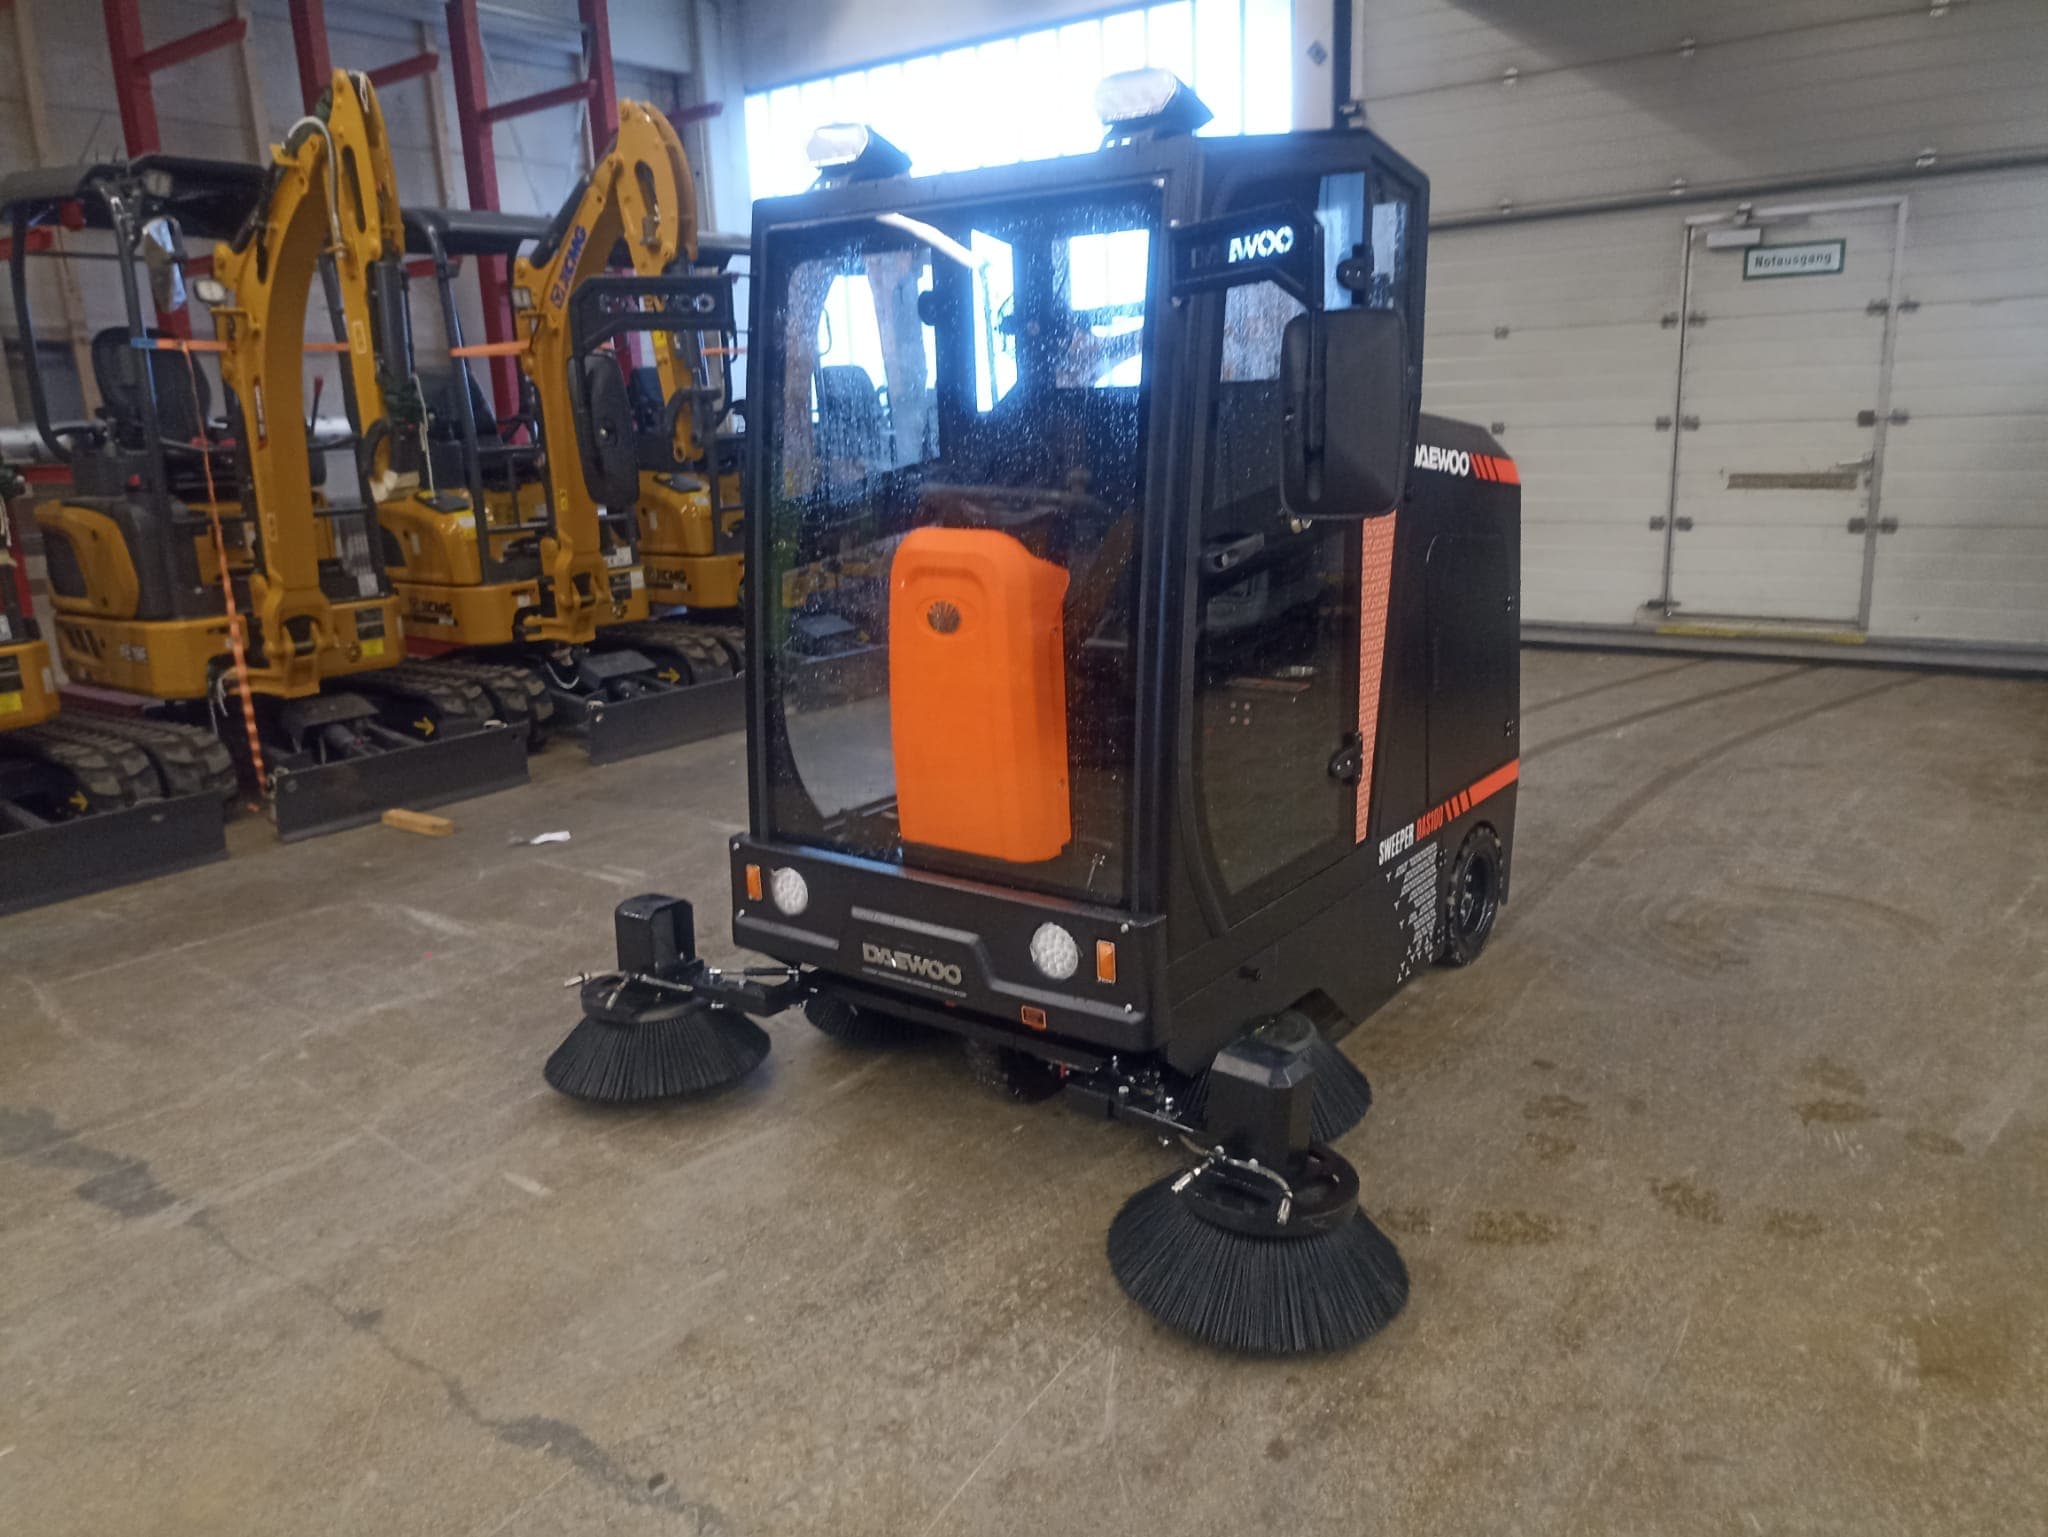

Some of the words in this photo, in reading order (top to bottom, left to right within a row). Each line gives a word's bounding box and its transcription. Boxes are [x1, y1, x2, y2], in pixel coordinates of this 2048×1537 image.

[1754, 252, 1833, 268] Notausgang
[1414, 444, 1470, 477] AEWOO
[1379, 822, 1415, 867] SWEEPER
[863, 942, 962, 986] DAEWOO
